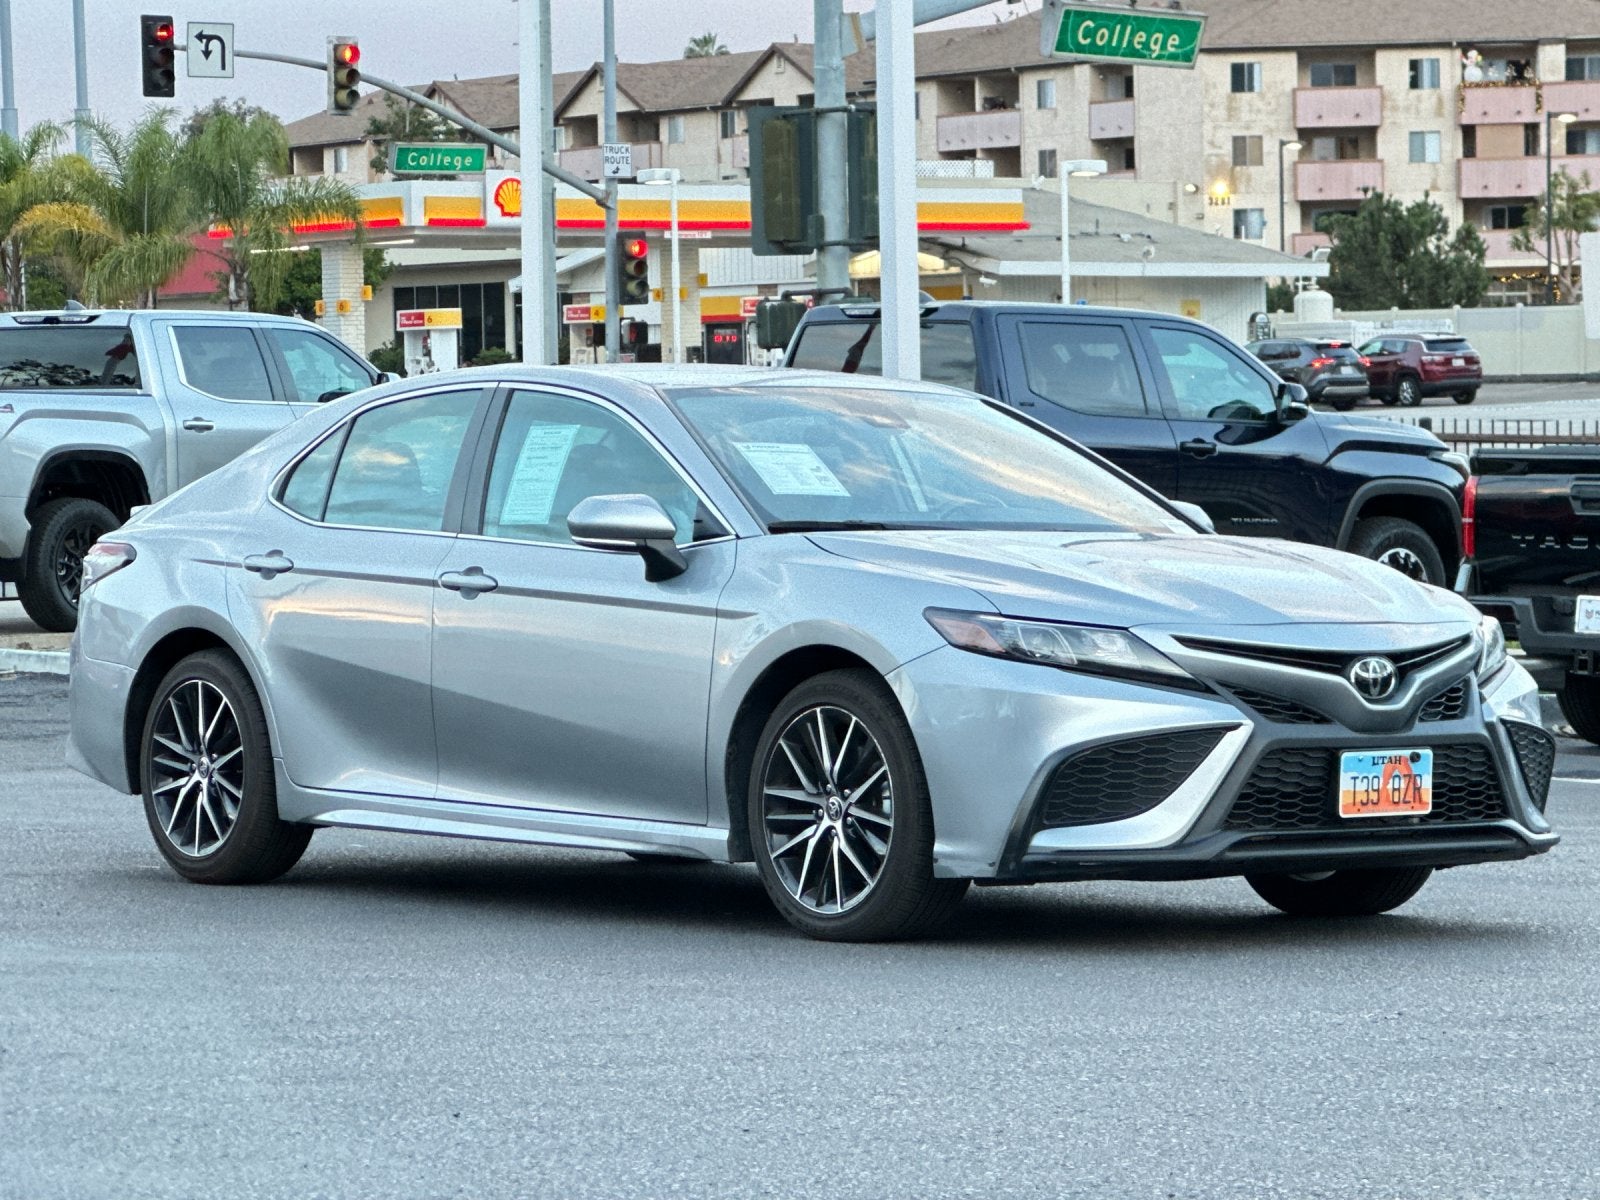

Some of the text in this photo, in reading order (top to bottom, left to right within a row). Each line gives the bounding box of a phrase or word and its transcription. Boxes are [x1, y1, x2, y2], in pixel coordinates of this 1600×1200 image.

[1077, 19, 1180, 59] College
[604, 145, 631, 155] TRUCK
[407, 152, 473, 170] College
[604, 156, 631, 165] ROUTE
[1511, 534, 1600, 550] TAC
[1372, 756, 1402, 766] UTAH
[1350, 776, 1381, 806] T39
